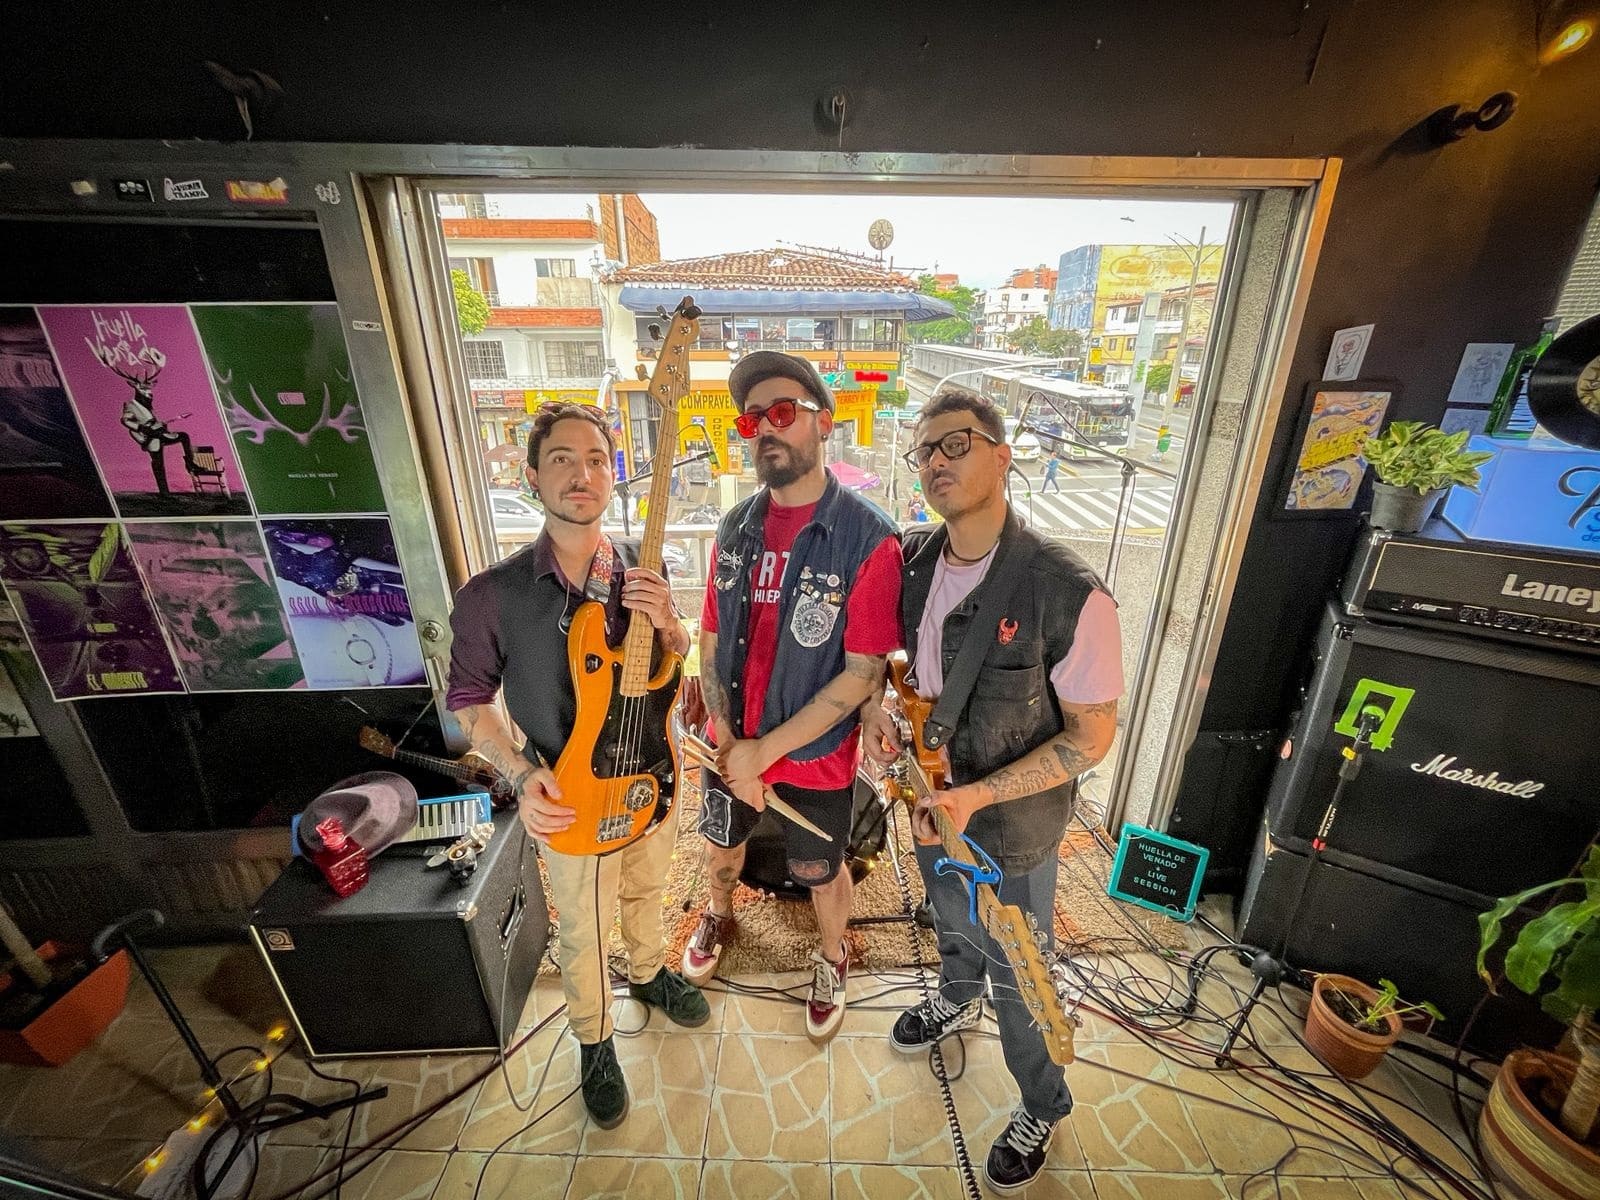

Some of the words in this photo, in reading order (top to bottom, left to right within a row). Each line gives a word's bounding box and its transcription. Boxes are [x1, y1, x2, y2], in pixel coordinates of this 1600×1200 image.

[1411, 753, 1545, 799] Marshall
[1138, 843, 1172, 859] HUELLA
[1174, 854, 1187, 863] DE
[1143, 853, 1177, 869] VENADO
[1133, 876, 1177, 896] SESSION
[1147, 870, 1168, 882] LIVE
